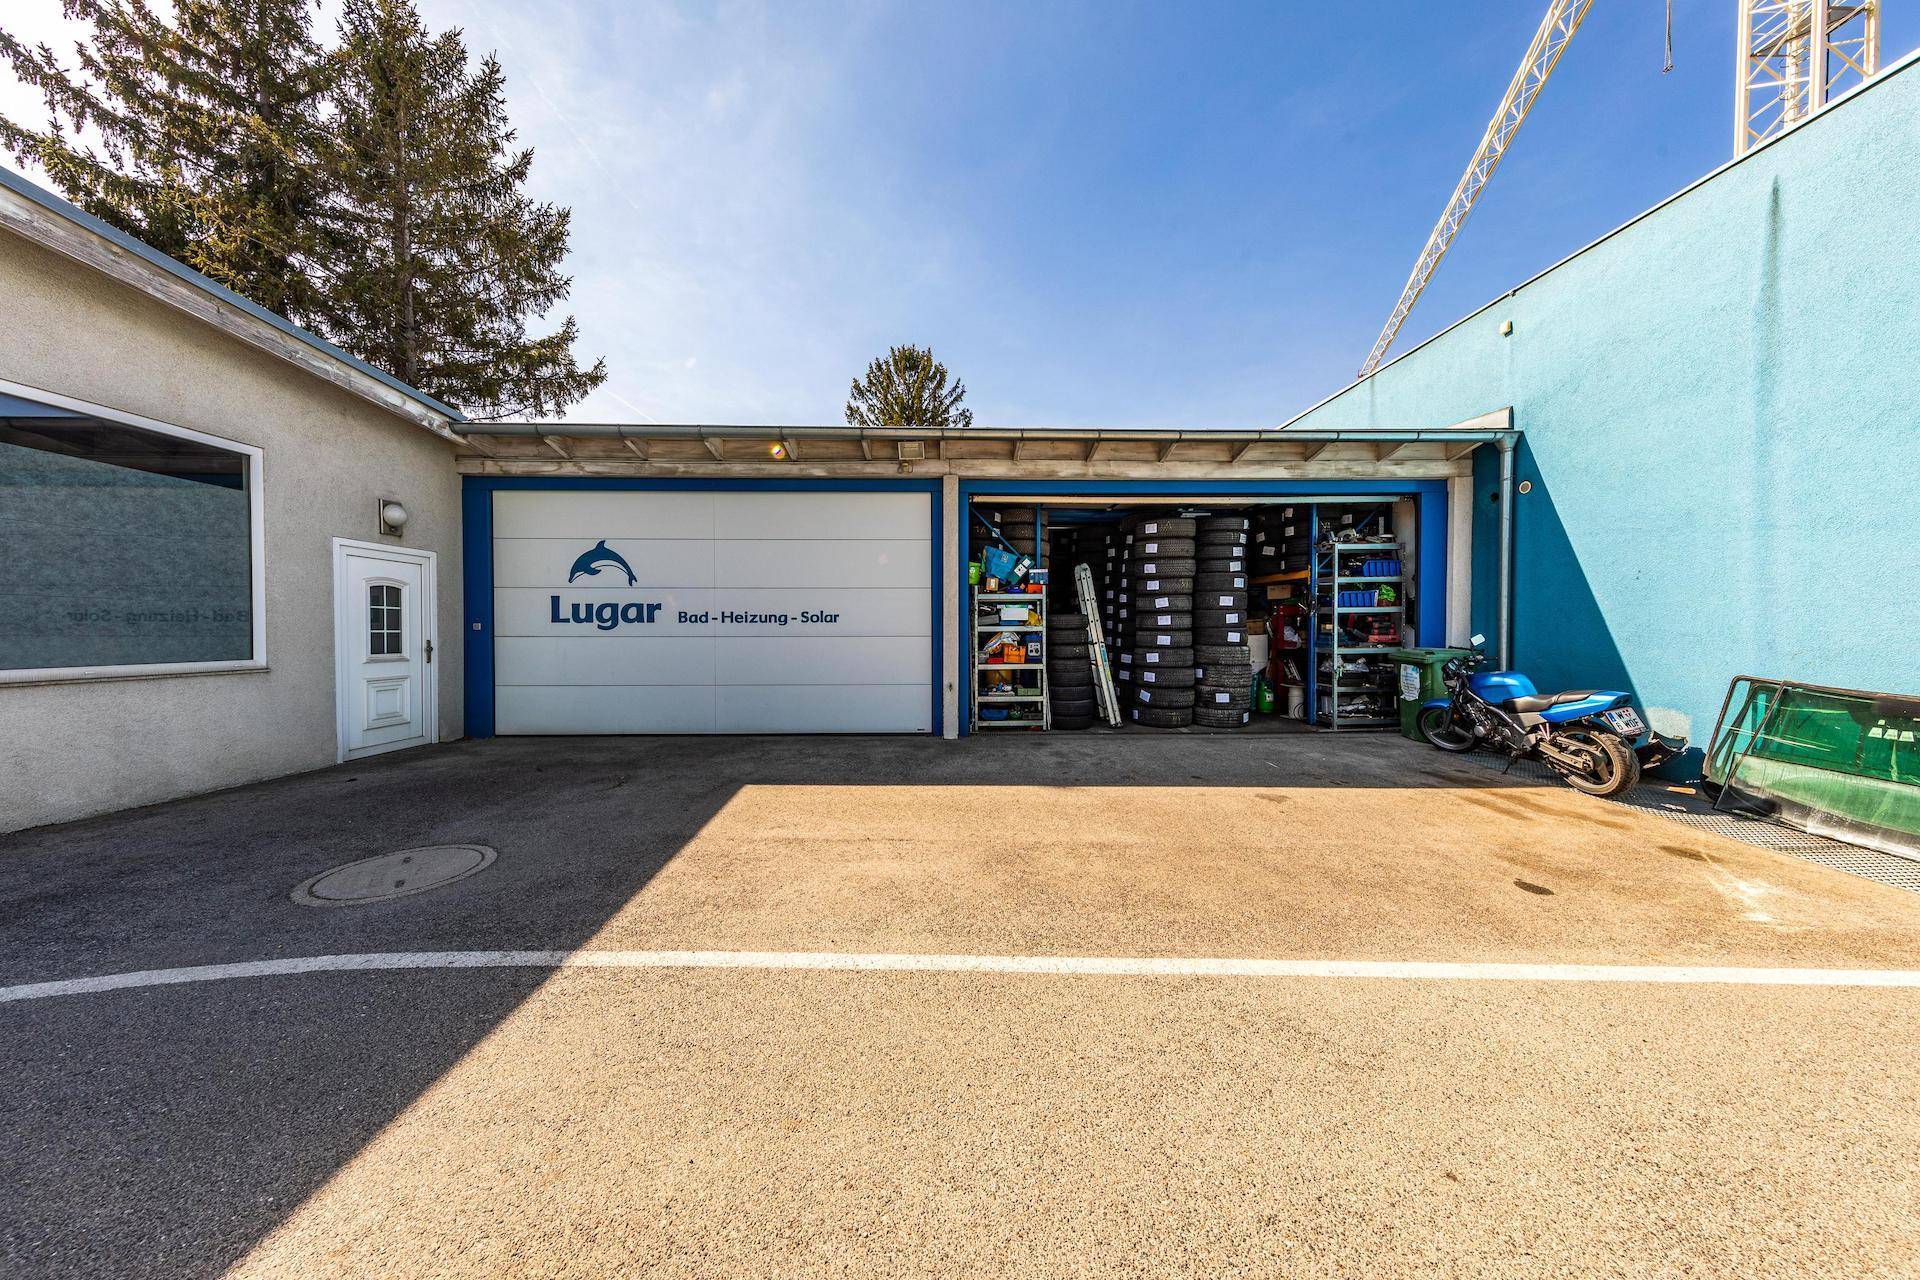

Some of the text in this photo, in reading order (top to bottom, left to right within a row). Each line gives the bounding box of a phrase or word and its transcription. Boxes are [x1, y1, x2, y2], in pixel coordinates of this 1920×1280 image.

[551, 595, 662, 631] Lugar
[678, 611, 709, 624] Bad
[721, 611, 788, 626] Heizung
[801, 610, 840, 624] Solar
[1615, 711, 1625, 719] W
